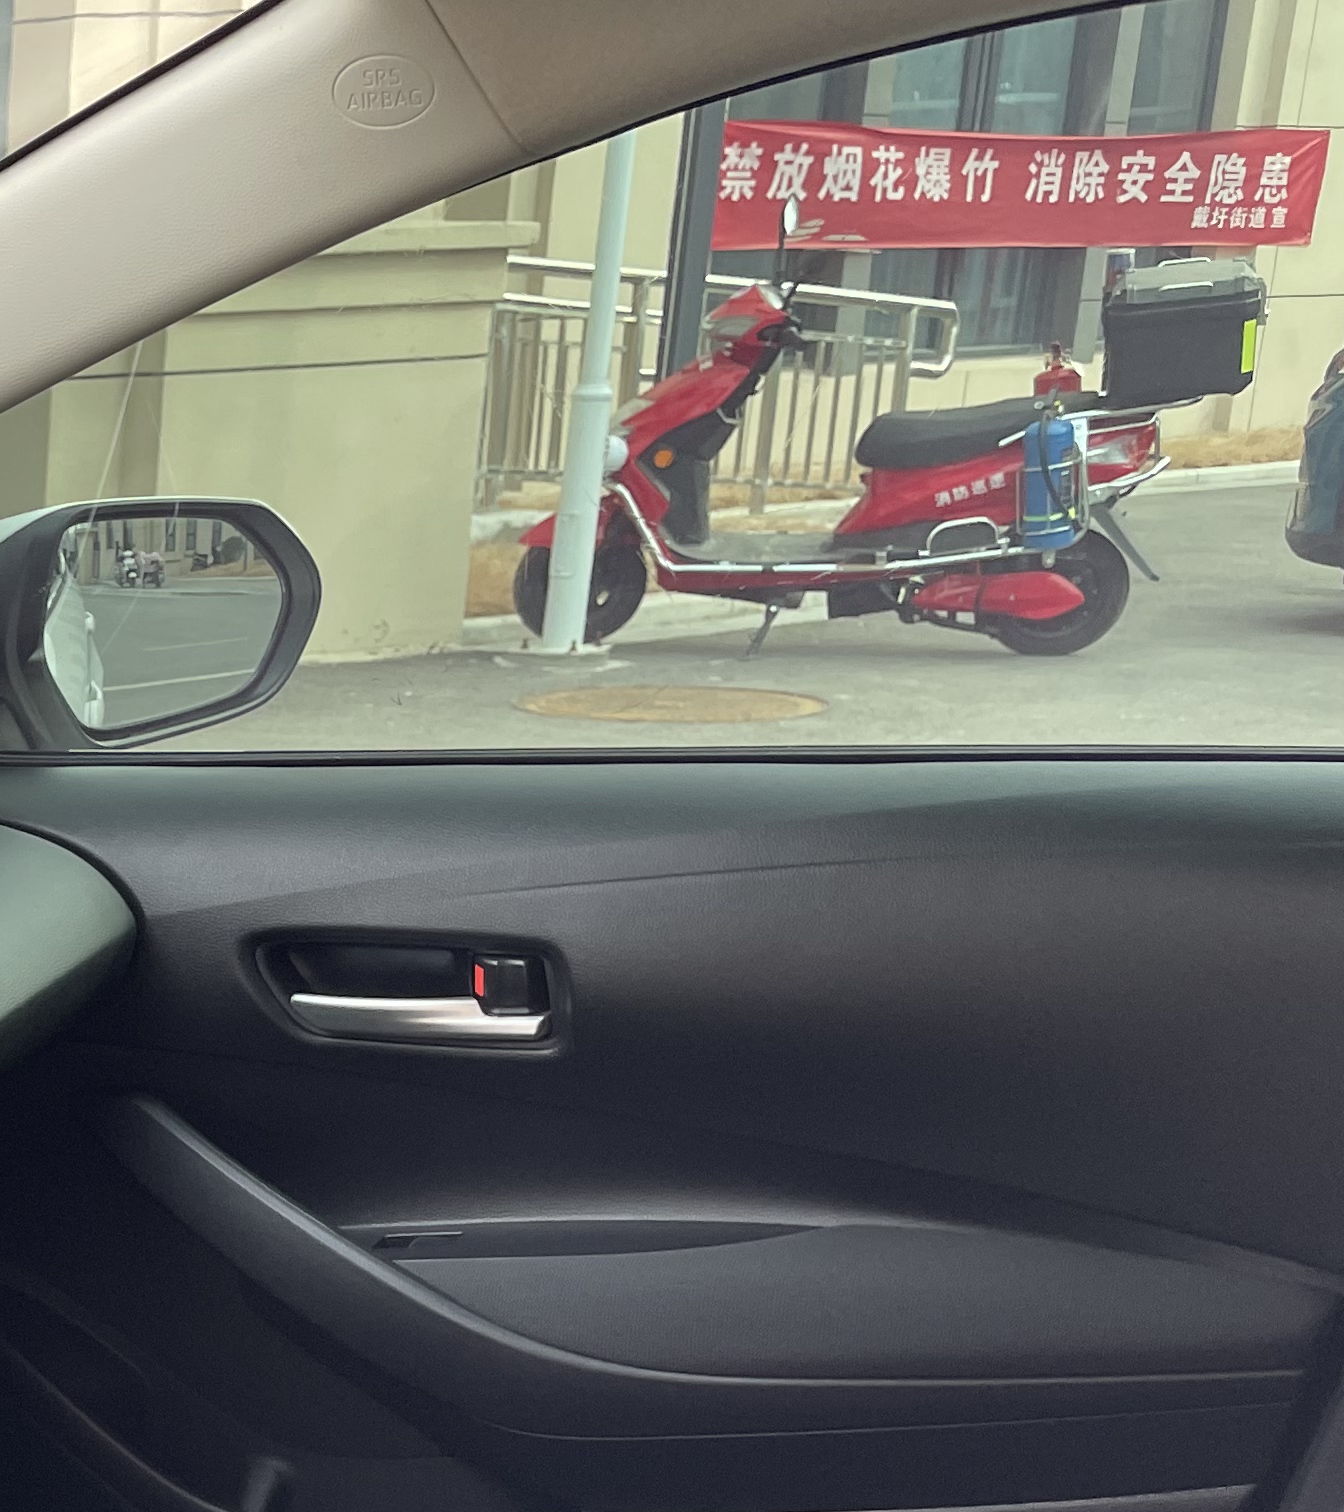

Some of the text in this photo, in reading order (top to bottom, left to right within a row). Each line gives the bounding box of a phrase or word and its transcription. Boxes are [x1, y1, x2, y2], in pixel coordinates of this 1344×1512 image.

[718, 142, 1291, 205] 禁放烟花爆竹 消除安全隐患
